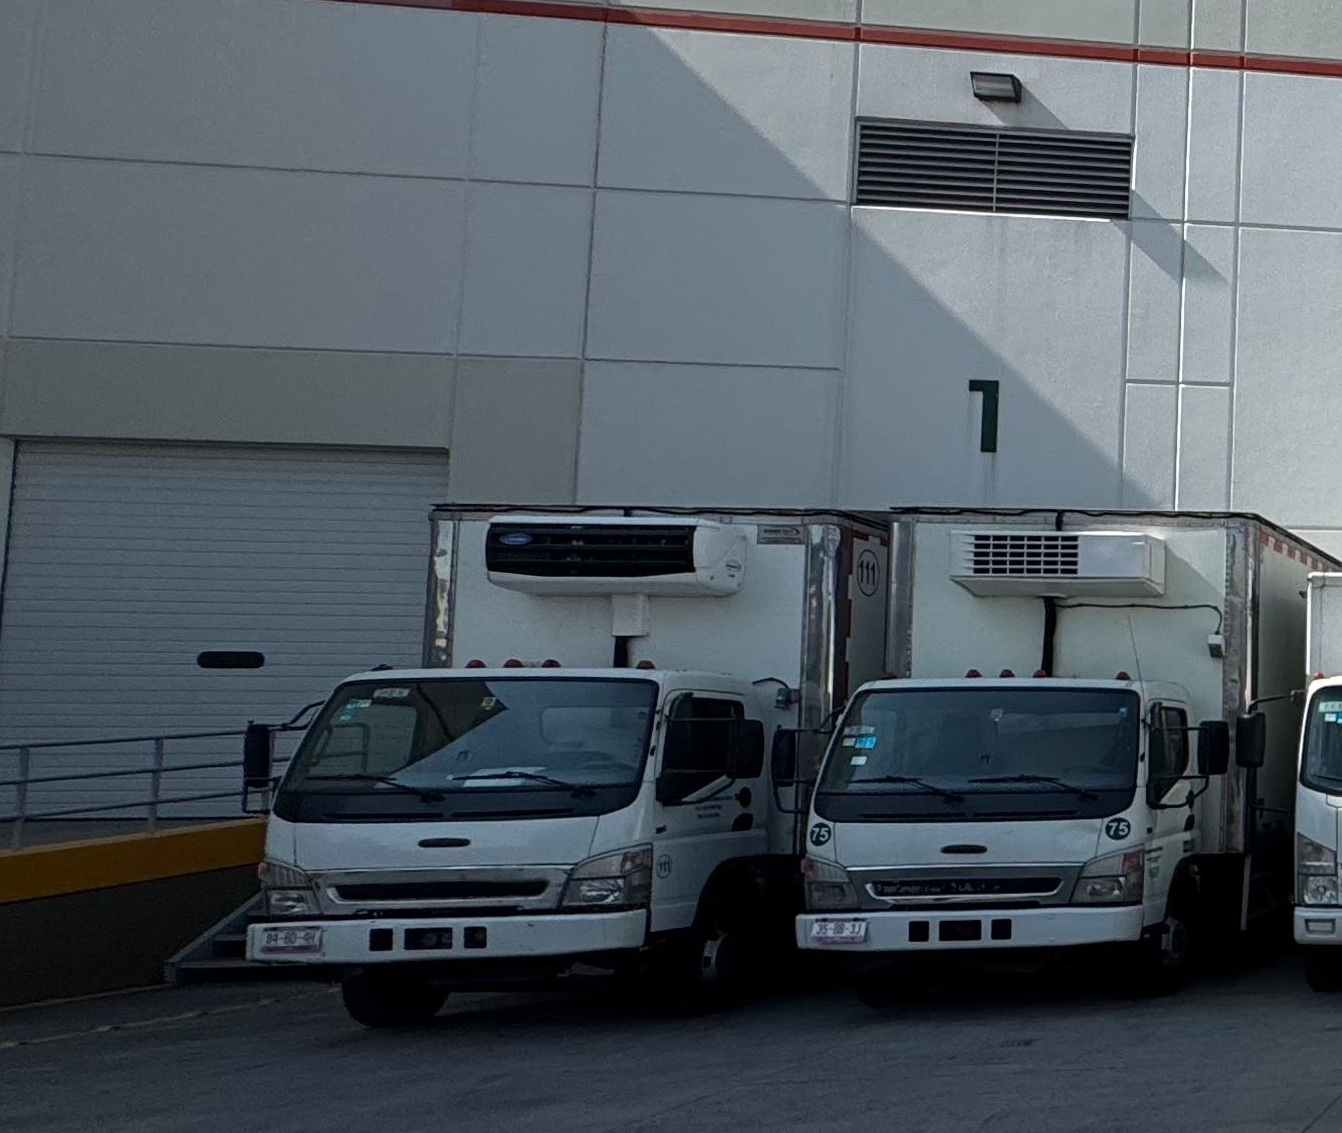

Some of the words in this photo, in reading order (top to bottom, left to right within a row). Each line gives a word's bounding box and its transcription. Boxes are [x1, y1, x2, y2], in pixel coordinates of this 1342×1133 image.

[969, 380, 1000, 454] 1
[859, 560, 875, 586] 111
[812, 827, 830, 841] 75
[1108, 822, 1129, 836] 75
